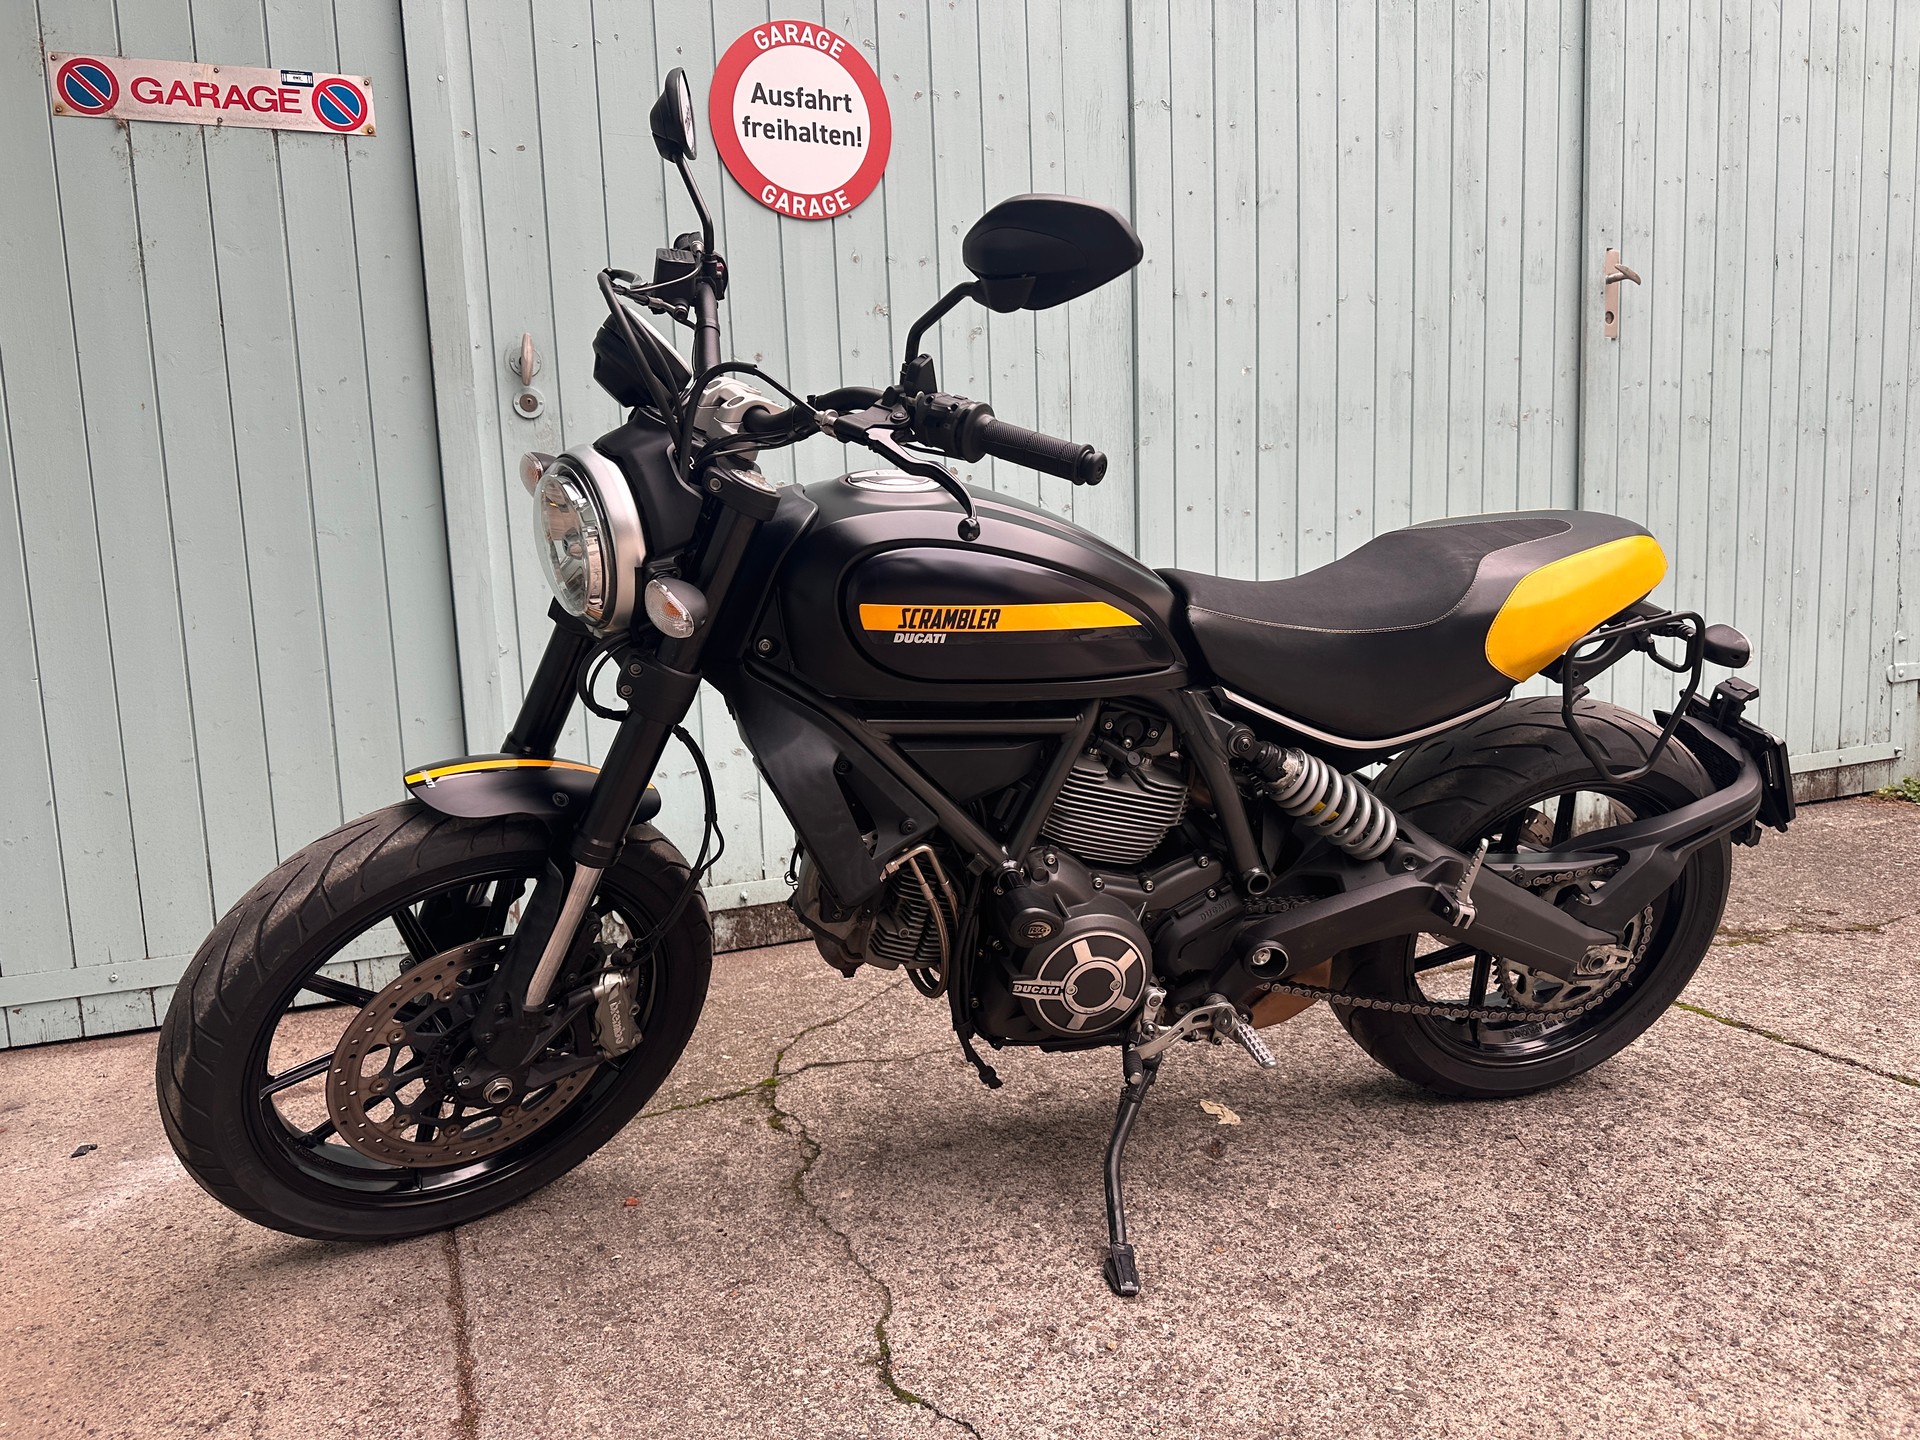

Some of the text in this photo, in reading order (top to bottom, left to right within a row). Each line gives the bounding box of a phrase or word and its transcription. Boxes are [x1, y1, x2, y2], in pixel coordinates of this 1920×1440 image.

[753, 24, 845, 59] GARAGE
[130, 76, 303, 114] GARAGE
[751, 82, 852, 113] Ausfahrt
[742, 116, 862, 147] freihalten!
[761, 184, 851, 216] GARAGE
[897, 608, 1001, 630] SCRAMBLER
[893, 633, 947, 644] DUCATI
[1200, 898, 1231, 920] DUCATI
[1012, 984, 1060, 995] DUCATI
[609, 1000, 625, 1044] brembo
